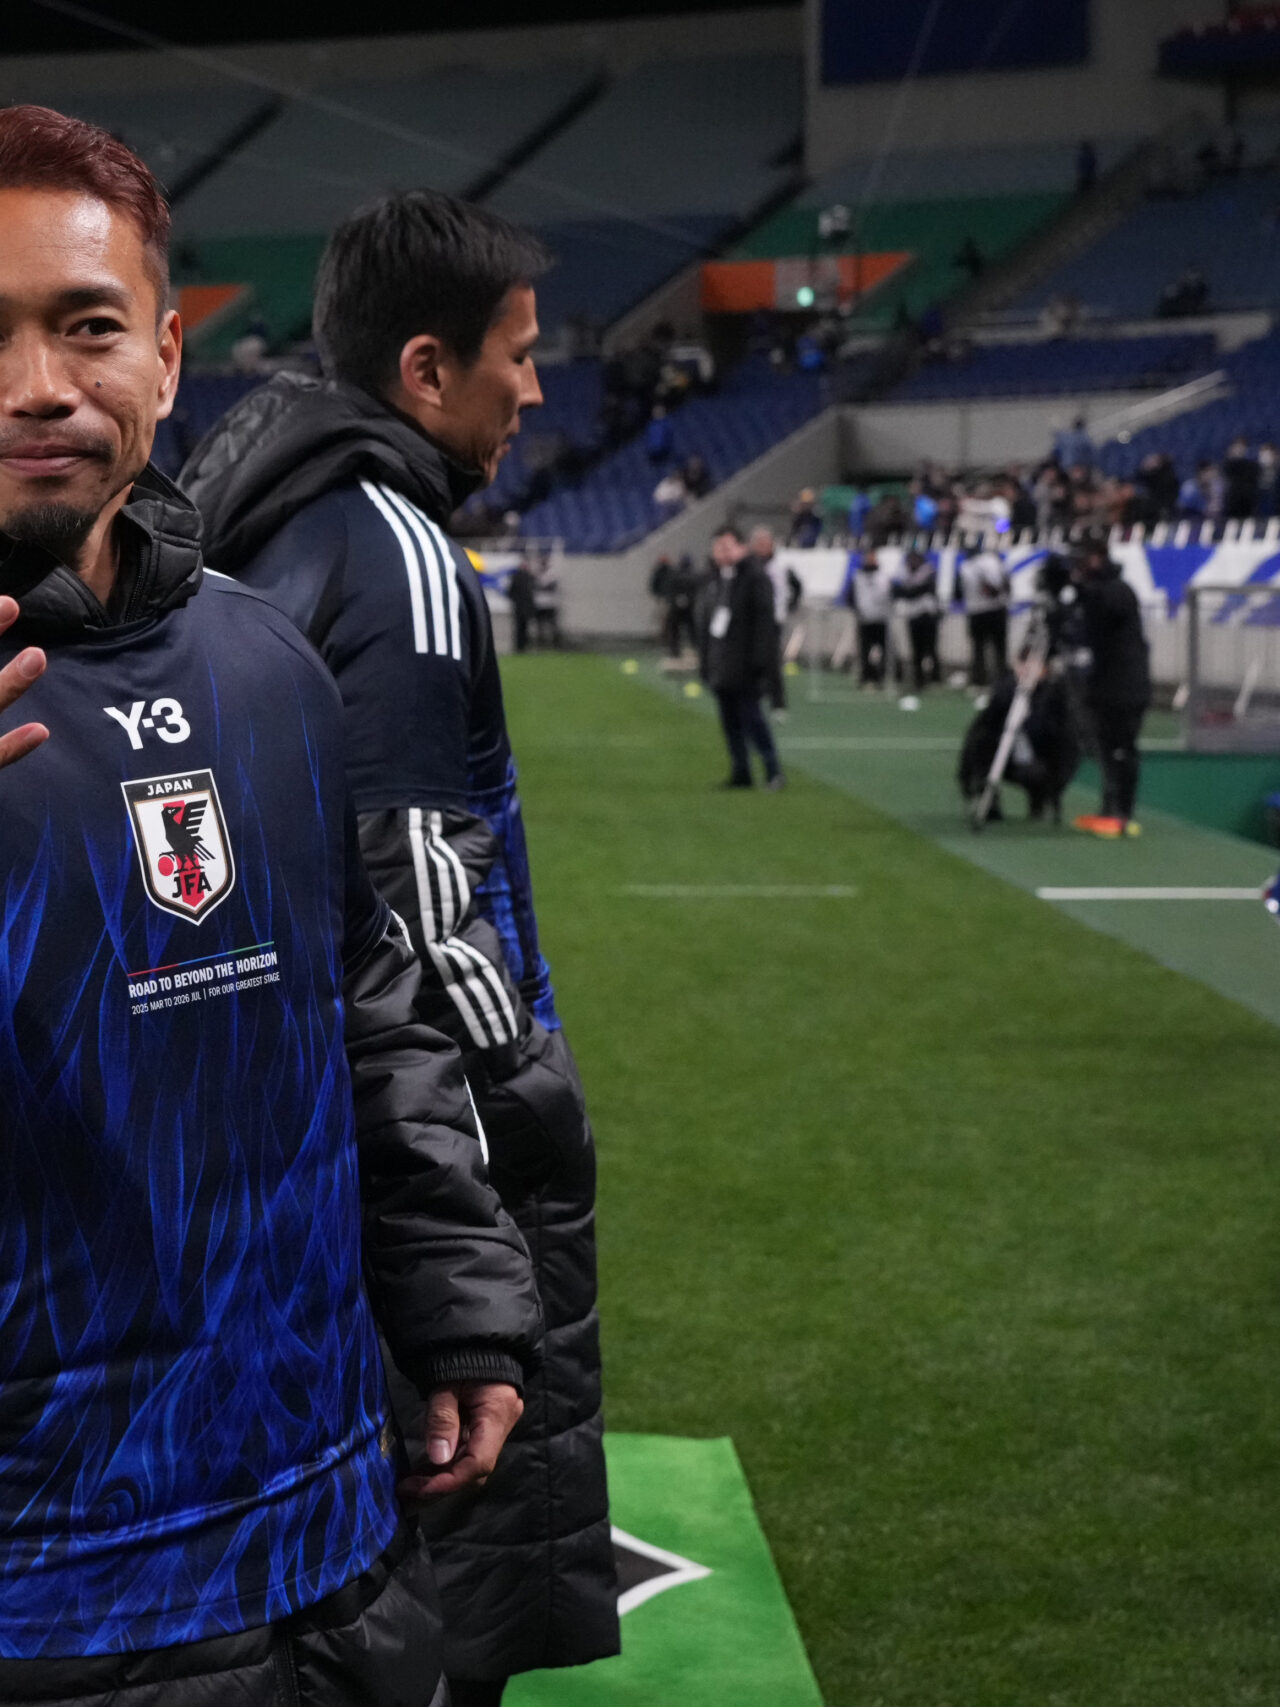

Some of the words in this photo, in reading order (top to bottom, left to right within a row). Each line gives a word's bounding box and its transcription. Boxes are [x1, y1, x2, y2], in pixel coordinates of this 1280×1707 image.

[103, 697, 191, 750] Y-3
[147, 778, 193, 796] JAPAN
[172, 871, 212, 898] JFA
[128, 982, 158, 998] ROAD
[158, 976, 172, 992] TO
[173, 966, 214, 988] BEYOND
[214, 961, 235, 979] THE
[236, 951, 278, 974] HORIZON
[131, 1002, 149, 1015] 2025
[149, 999, 165, 1011] MAR
[164, 997, 173, 1008] TO
[173, 993, 190, 1006] 2026
[191, 991, 202, 1002] JUL
[208, 986, 221, 997] FOR
[221, 982, 235, 994] OUR
[235, 975, 263, 991] GREATEST
[263, 971, 280, 984] STAGE
